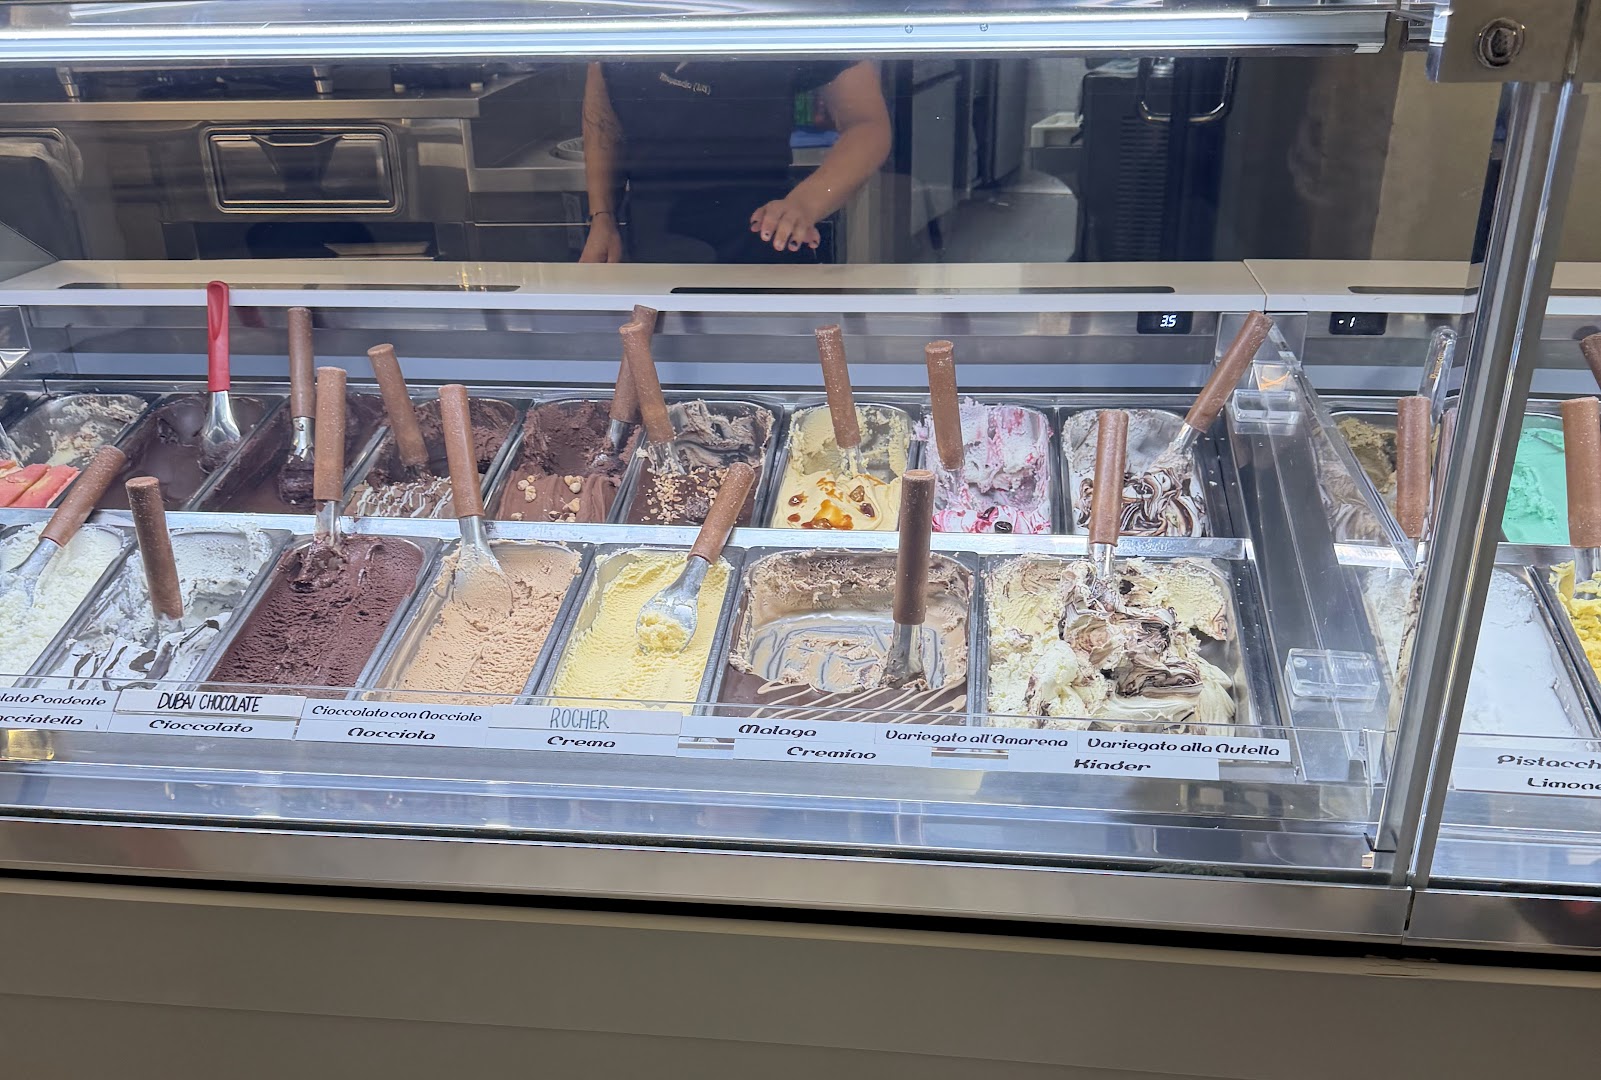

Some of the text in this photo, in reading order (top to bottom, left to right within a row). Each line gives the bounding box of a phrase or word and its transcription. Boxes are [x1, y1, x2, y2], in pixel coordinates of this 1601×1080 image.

[0, 693, 106, 706] lato Fondente
[158, 692, 263, 713] DUBAI CHOCOLATE
[312, 706, 482, 722] Cioccolato con Nocciole
[550, 708, 609, 730] ROCHER
[149, 719, 253, 734] Cioccolato
[348, 727, 435, 740] Nocciola
[738, 724, 817, 738] Malaga
[547, 736, 615, 748] Crema
[886, 729, 1069, 747] Variegato all'Amarena
[786, 746, 877, 760] Cremino
[1087, 738, 1280, 756] Variegato alla Nutella
[1074, 759, 1150, 772] Kinder
